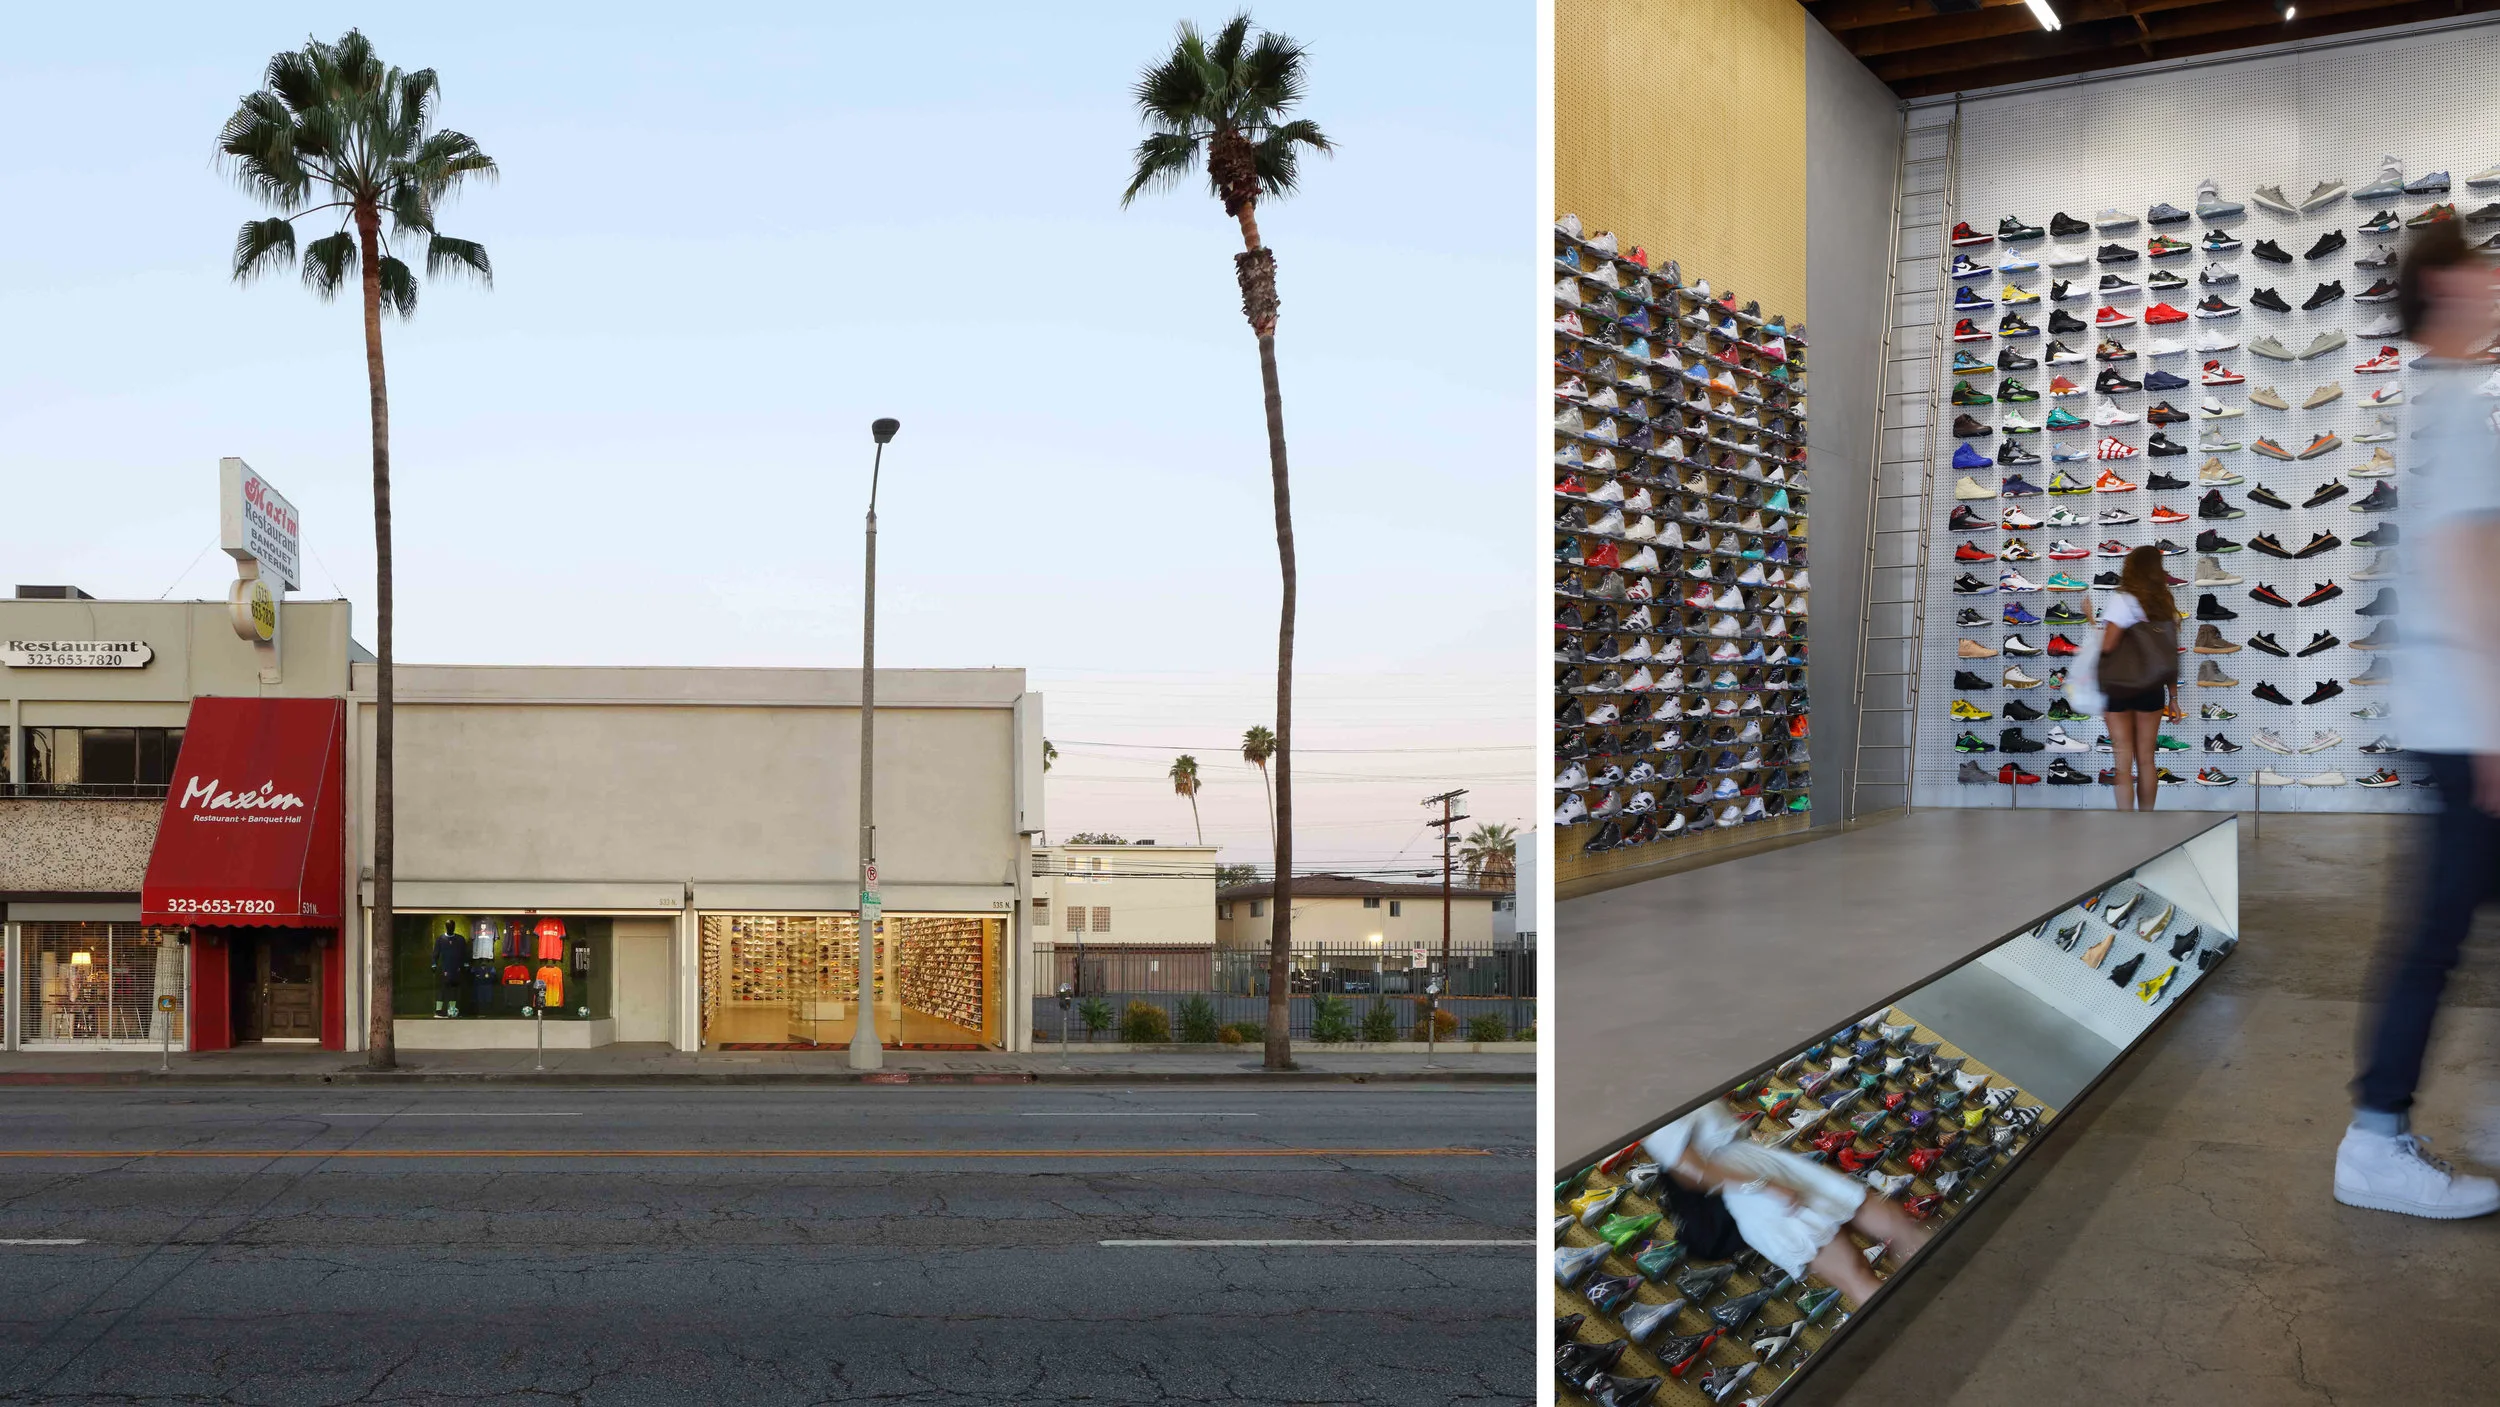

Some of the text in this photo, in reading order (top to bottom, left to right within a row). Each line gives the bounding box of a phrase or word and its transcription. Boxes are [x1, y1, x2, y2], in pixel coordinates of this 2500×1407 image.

[245, 477, 297, 538] Maxim
[245, 500, 297, 556] Restaurant
[251, 528, 292, 566] BANQUET
[250, 541, 294, 579] CATERING
[9, 641, 139, 652] Restaurant
[180, 776, 304, 810] Maxim
[193, 815, 239, 823] Restaurant
[248, 815, 283, 823] Banquet
[284, 815, 302, 823] Hall
[167, 899, 275, 913] 323-653-7820
[302, 902, 312, 914] 531
[659, 898, 670, 906] 533
[993, 901, 1004, 909] 535
